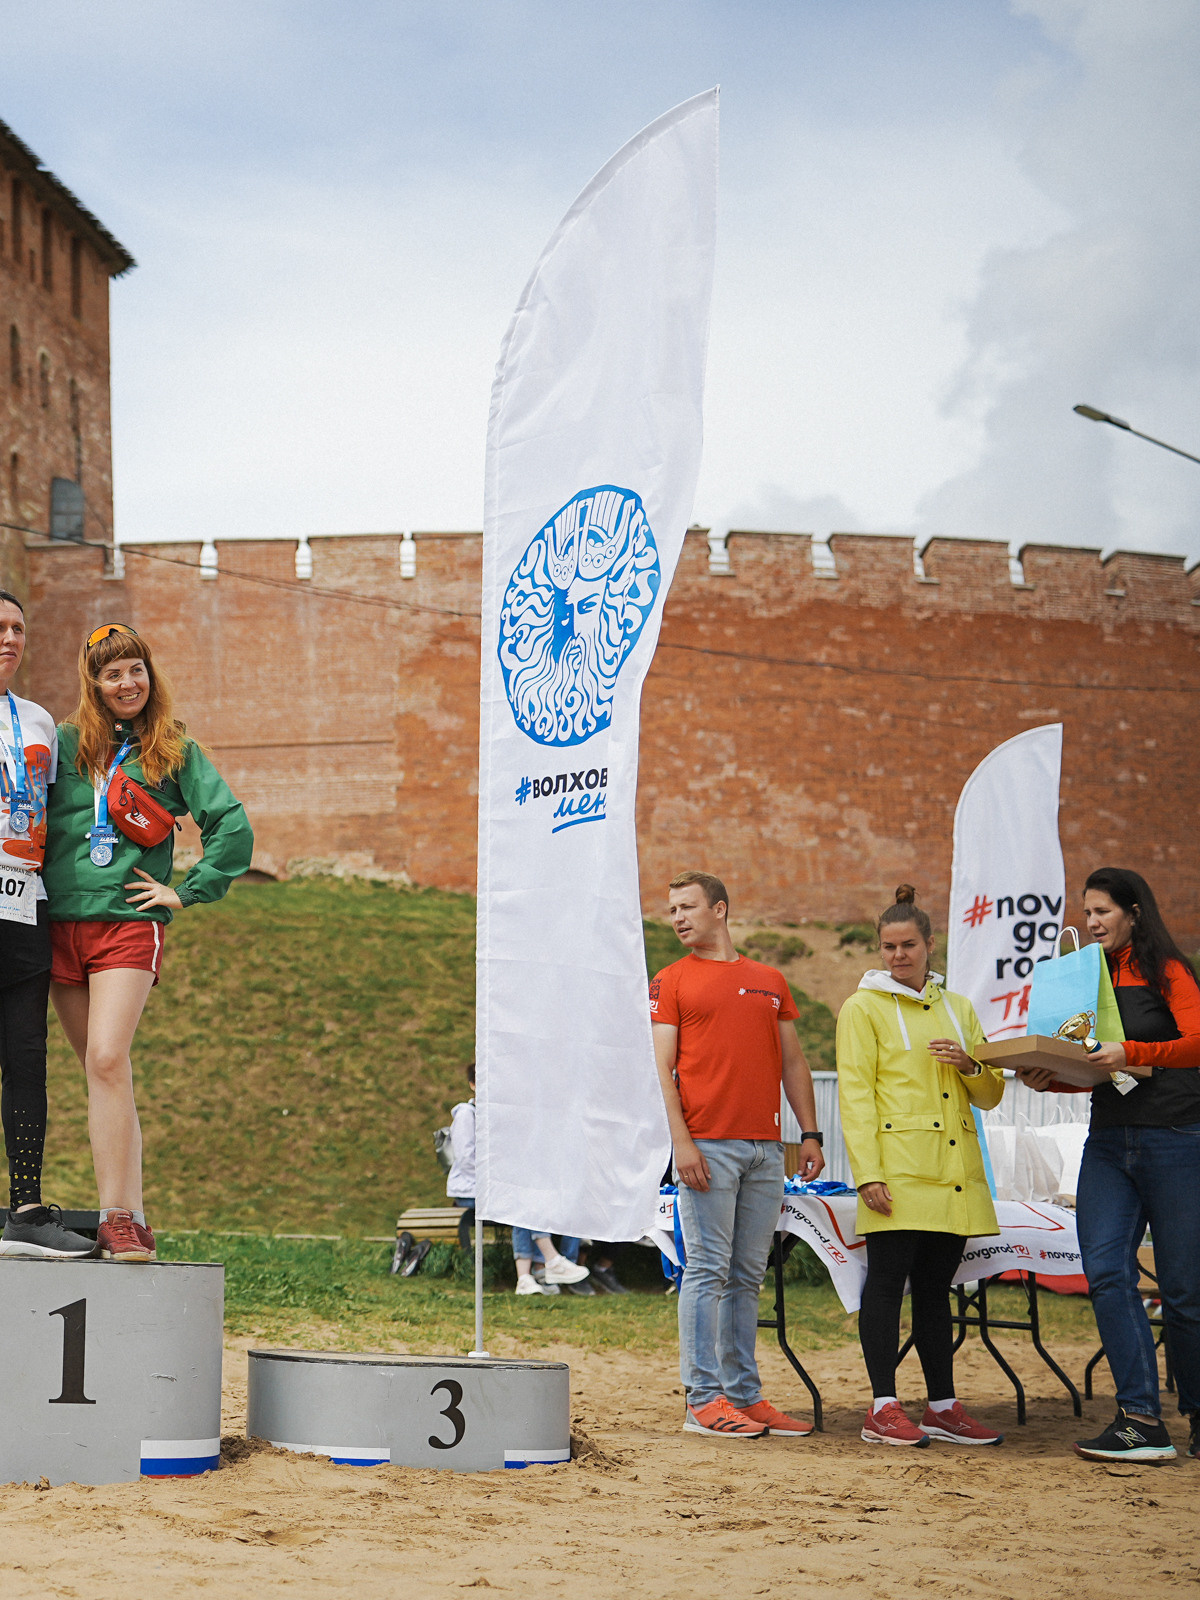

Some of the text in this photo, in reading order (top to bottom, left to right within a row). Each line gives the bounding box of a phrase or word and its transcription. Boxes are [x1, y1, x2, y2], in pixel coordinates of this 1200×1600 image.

[515, 768, 607, 805] #ВОЛХОВ
[963, 894, 1062, 927] #nov
[49, 1298, 97, 1405] 1
[428, 1379, 466, 1450] 3
